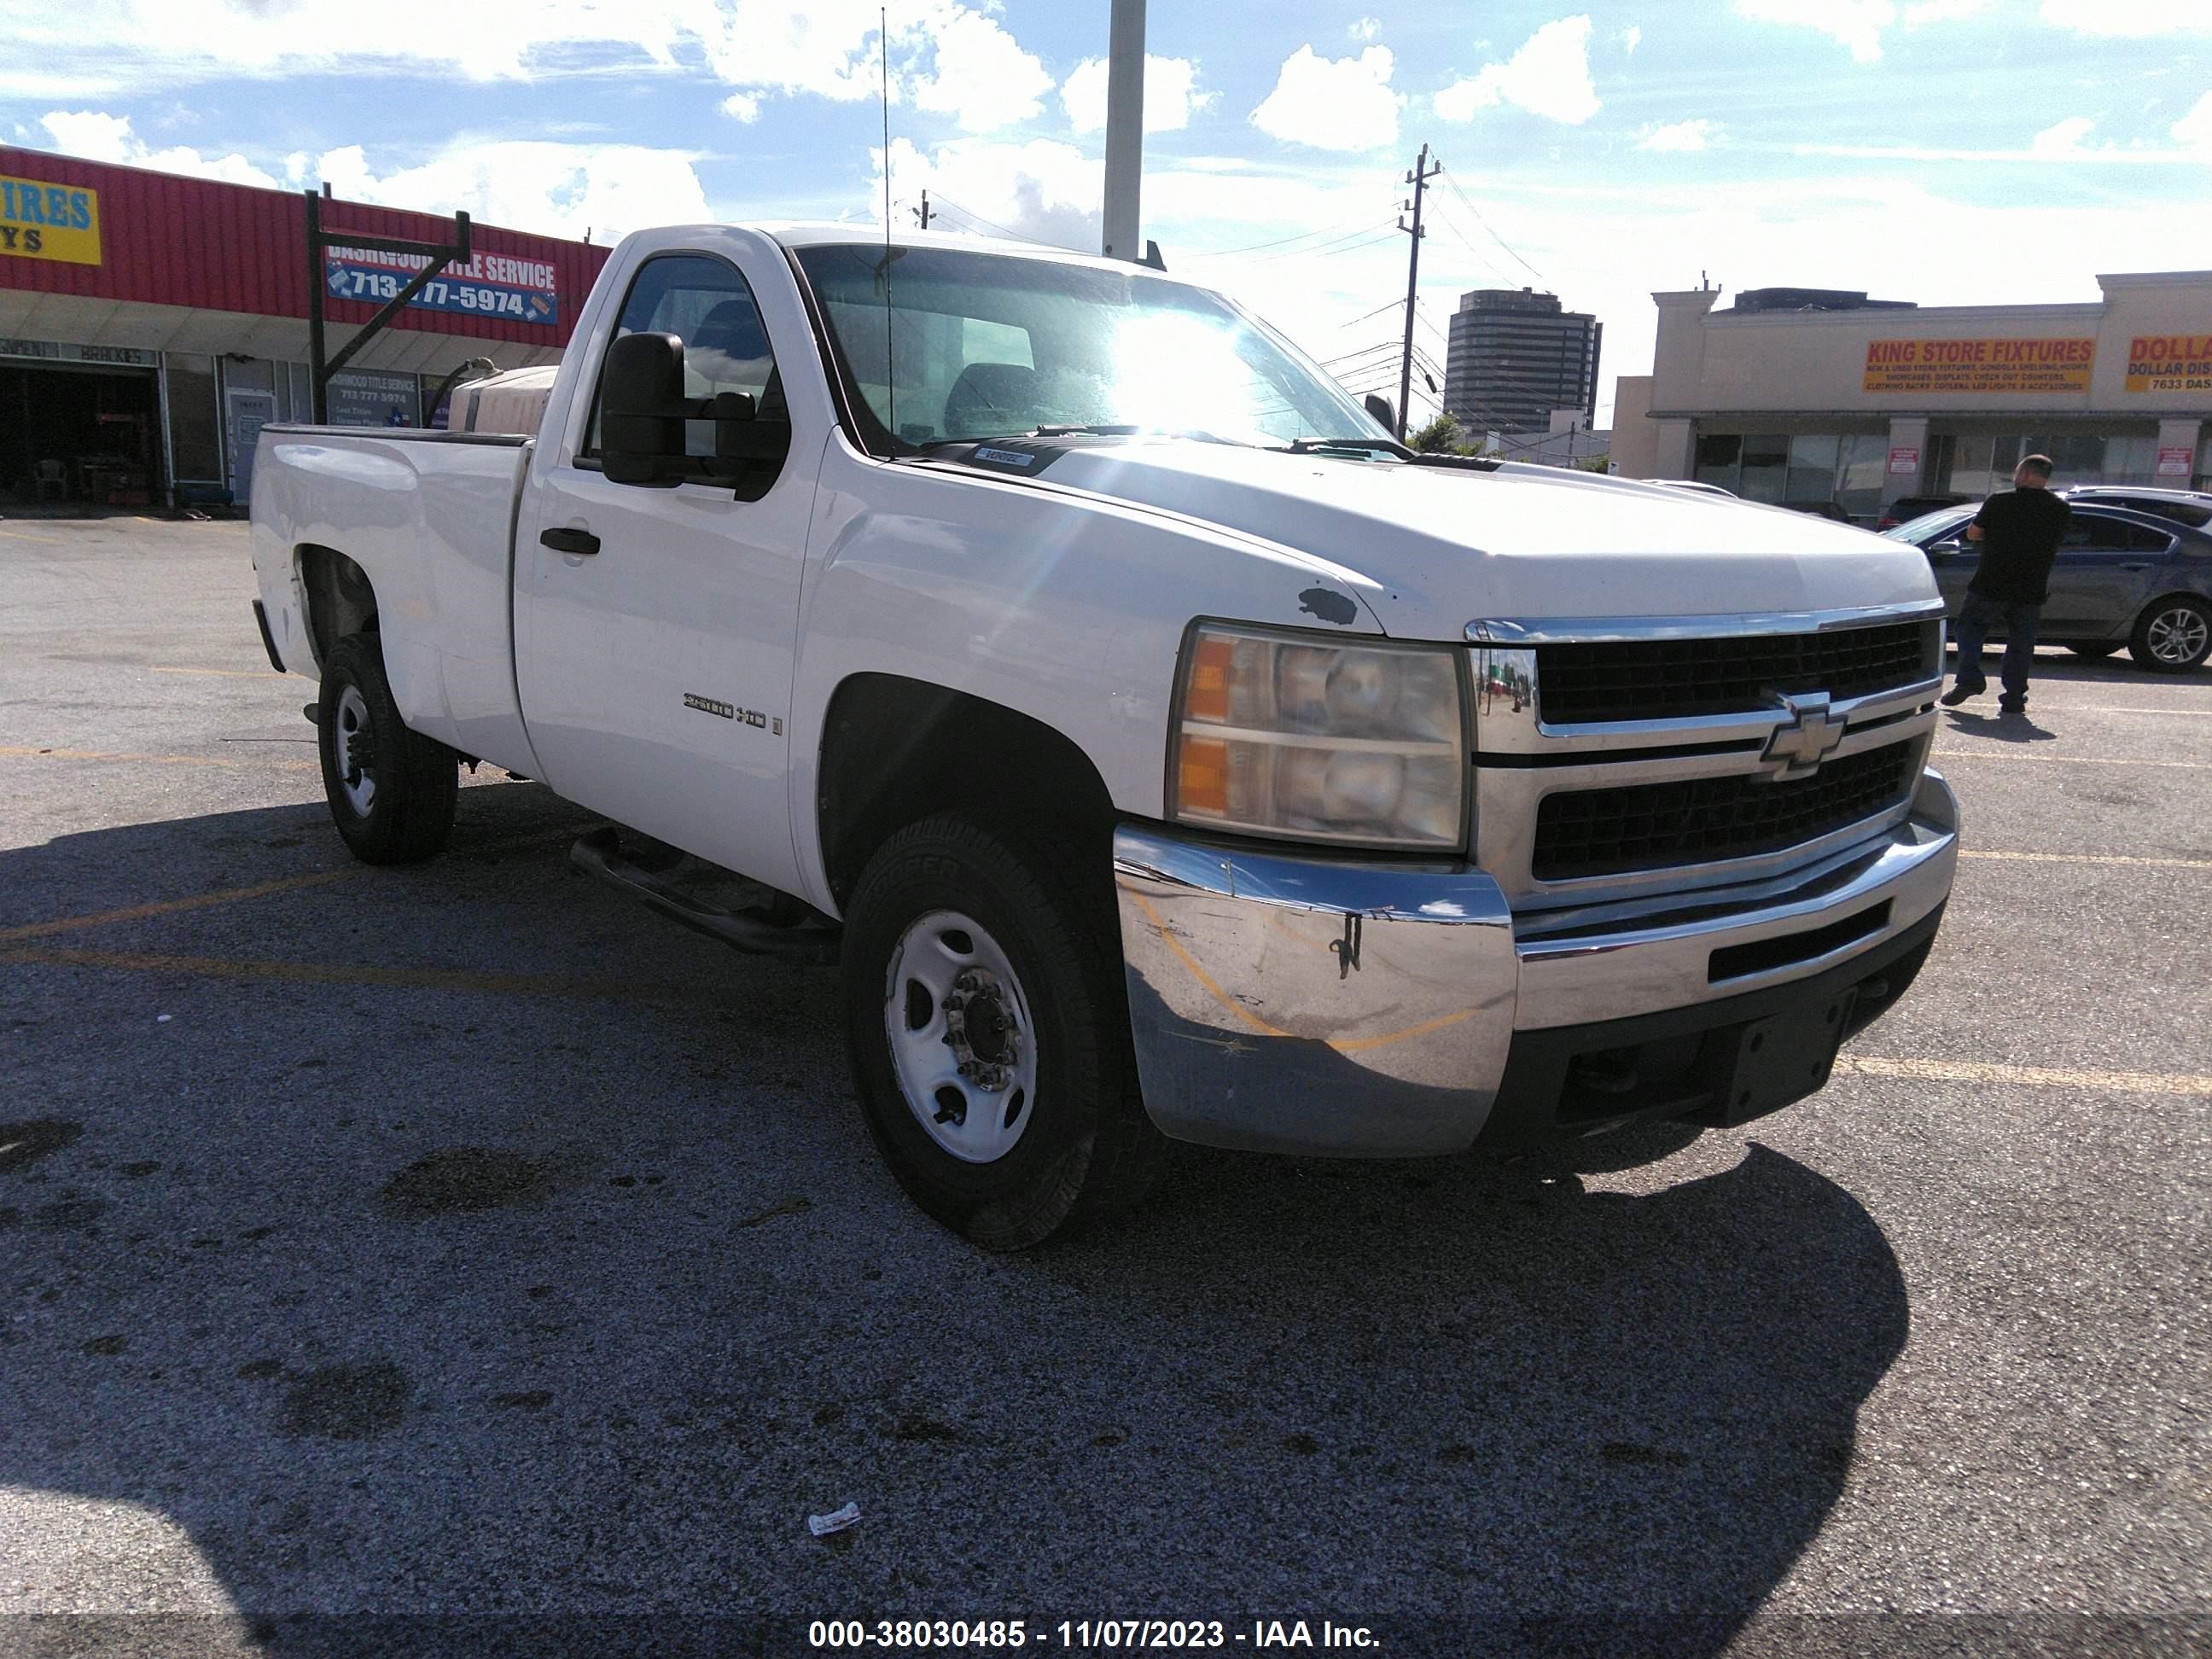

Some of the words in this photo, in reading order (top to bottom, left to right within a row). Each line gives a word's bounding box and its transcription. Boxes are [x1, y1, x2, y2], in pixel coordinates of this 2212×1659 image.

[486, 253, 556, 290] SERVICE
[351, 271, 524, 315] 713-77-5974
[1869, 342, 1917, 363] KING
[1923, 341, 1988, 363] STORE
[1993, 341, 2093, 362] FIXTURES
[2128, 363, 2183, 375] DOLLAR
[388, 379, 416, 393] SERVICE
[2152, 379, 2183, 389] 7633
